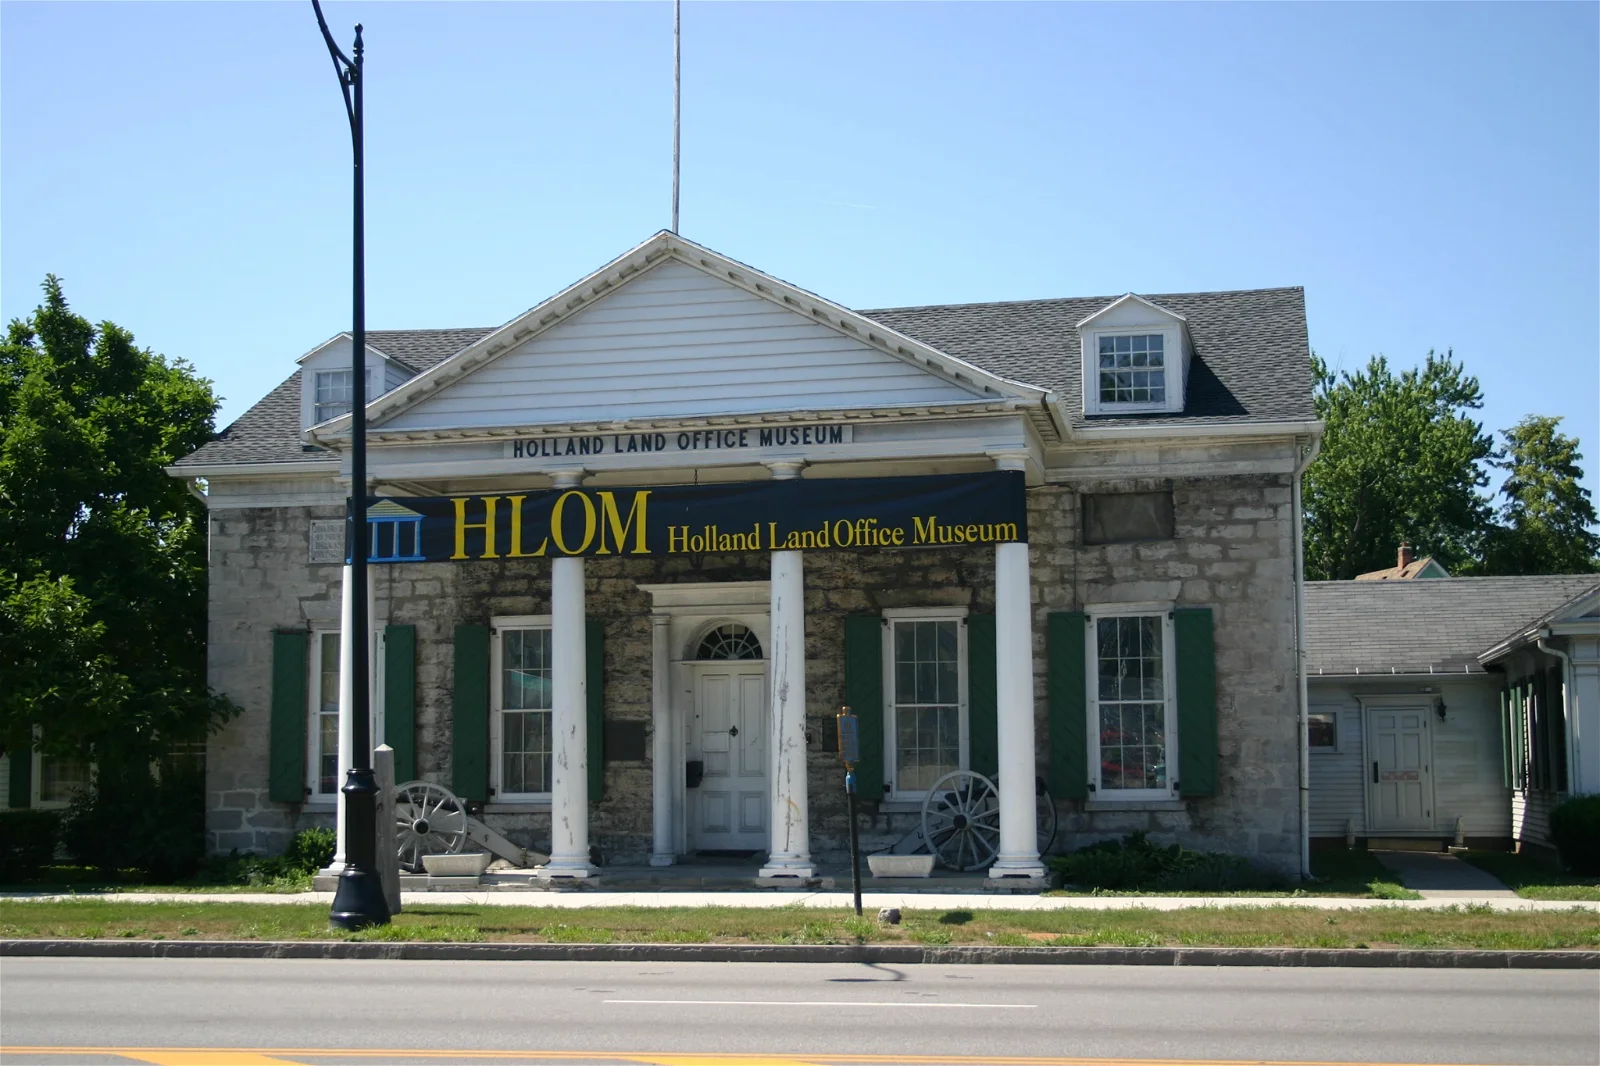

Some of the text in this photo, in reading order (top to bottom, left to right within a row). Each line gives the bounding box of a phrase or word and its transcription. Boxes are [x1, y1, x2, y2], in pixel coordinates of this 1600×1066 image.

[513, 425, 843, 458] HOLLAND LAND OFFICE MUSEUM
[449, 490, 652, 560] HLOM
[667, 515, 1018, 553] Holland Land Office Museum
